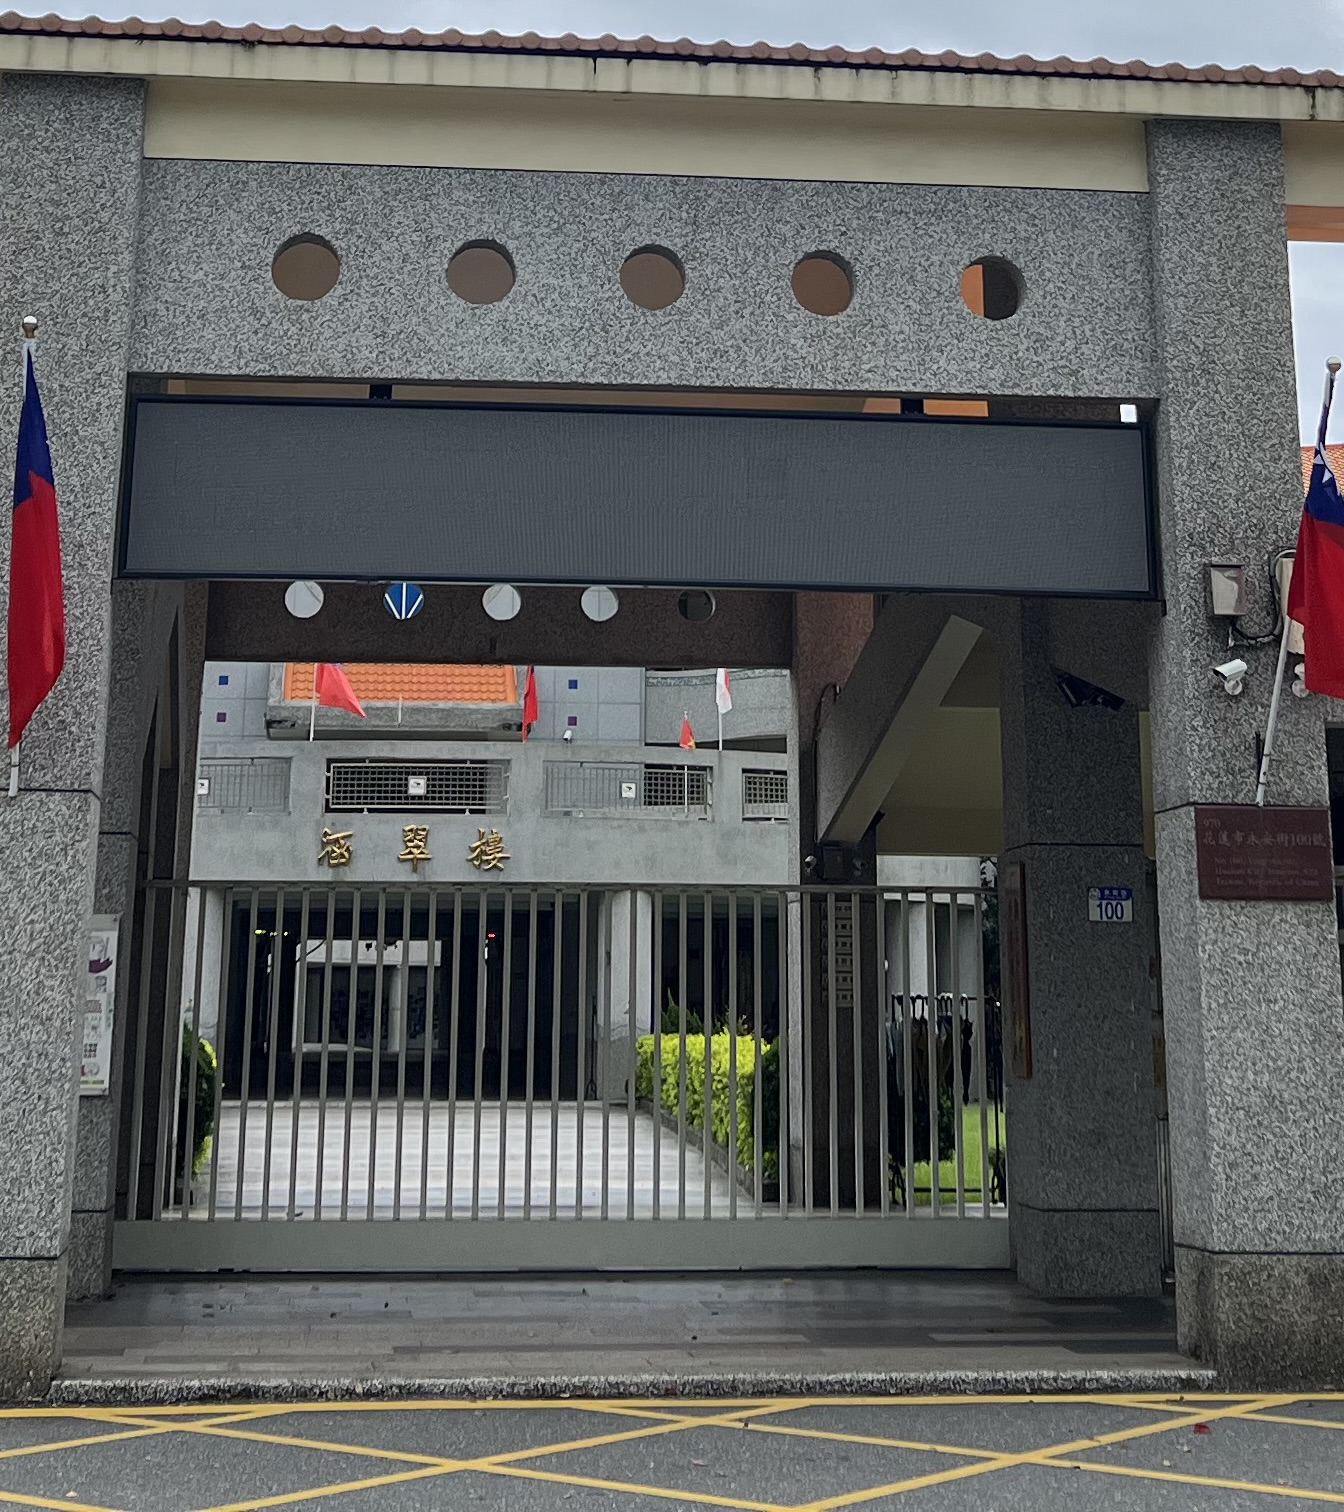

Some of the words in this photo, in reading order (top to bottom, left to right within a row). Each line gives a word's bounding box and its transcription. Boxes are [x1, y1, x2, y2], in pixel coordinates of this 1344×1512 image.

[316, 823, 513, 873] 涵翠樓
[1096, 901, 1125, 921] 100
